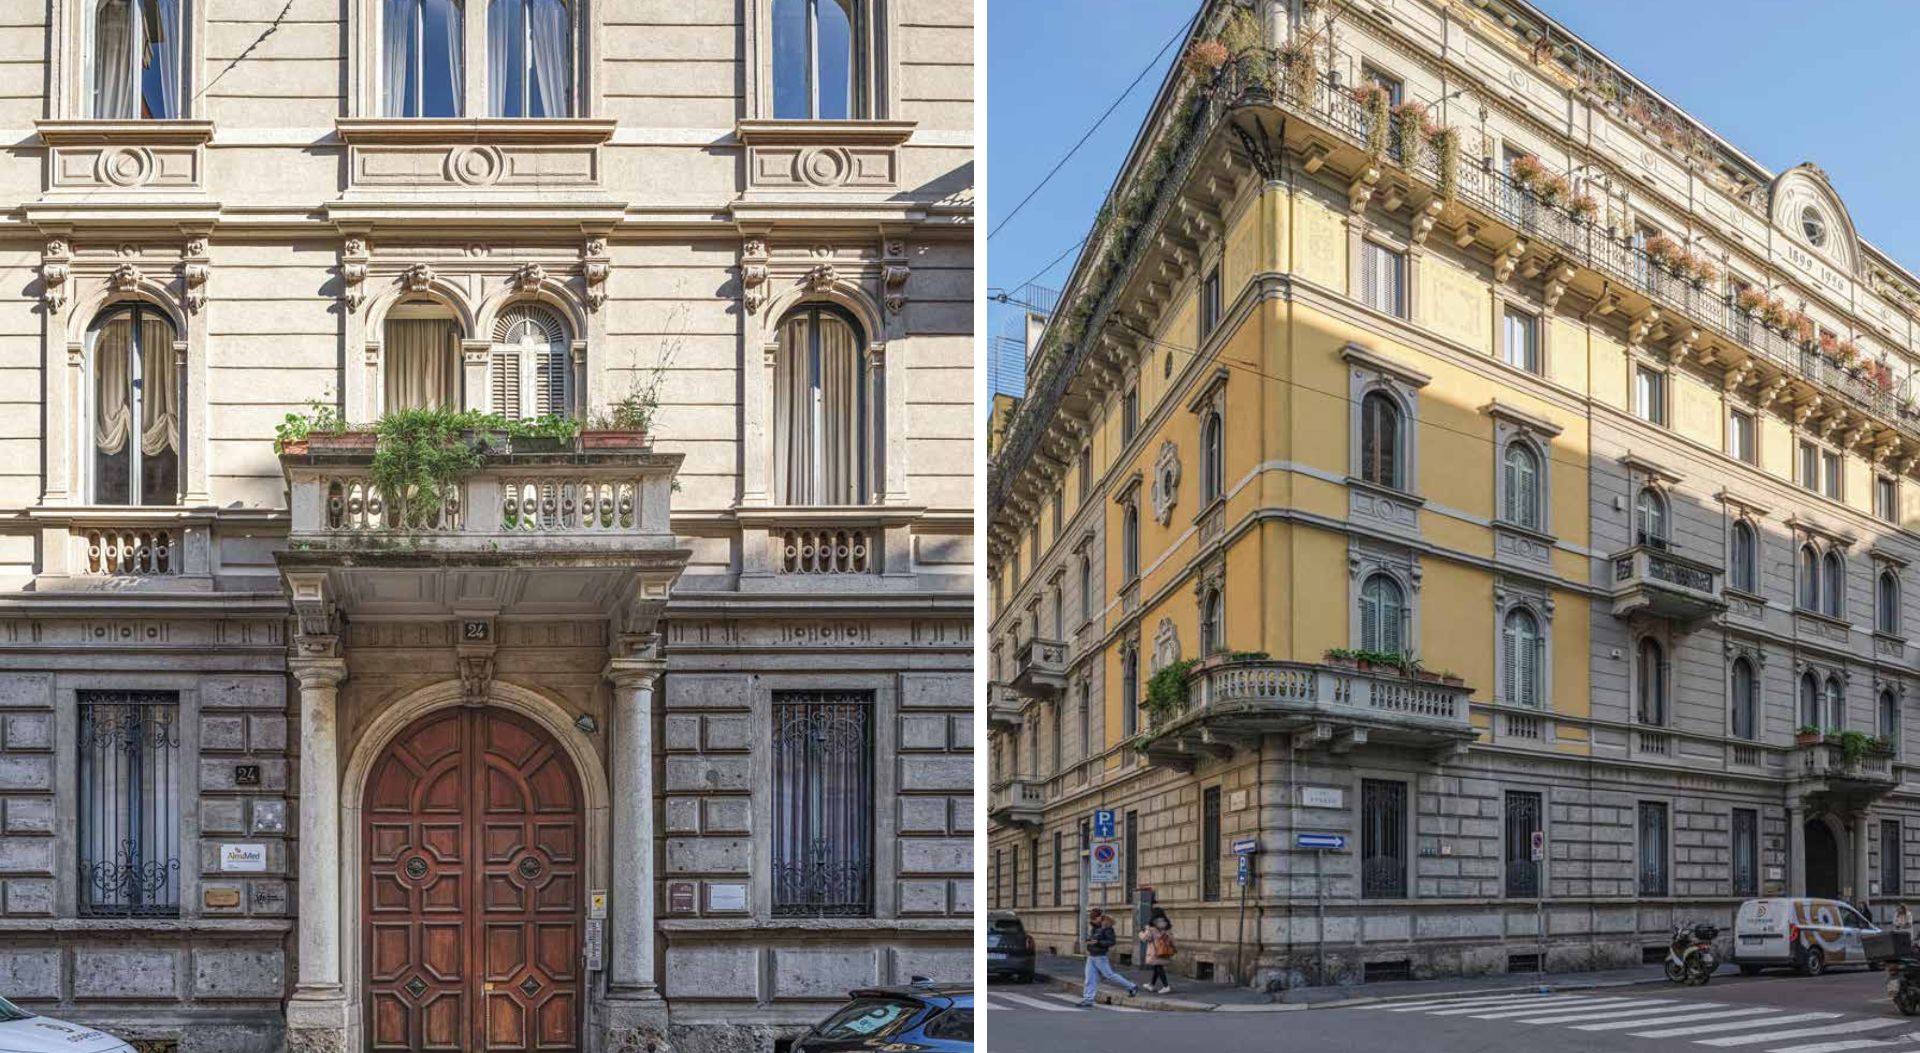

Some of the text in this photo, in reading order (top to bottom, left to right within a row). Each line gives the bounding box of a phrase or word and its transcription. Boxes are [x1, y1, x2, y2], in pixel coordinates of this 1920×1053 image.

[467, 623, 485, 638] 24
[237, 767, 257, 781] 24
[1099, 811, 1111, 825] P
